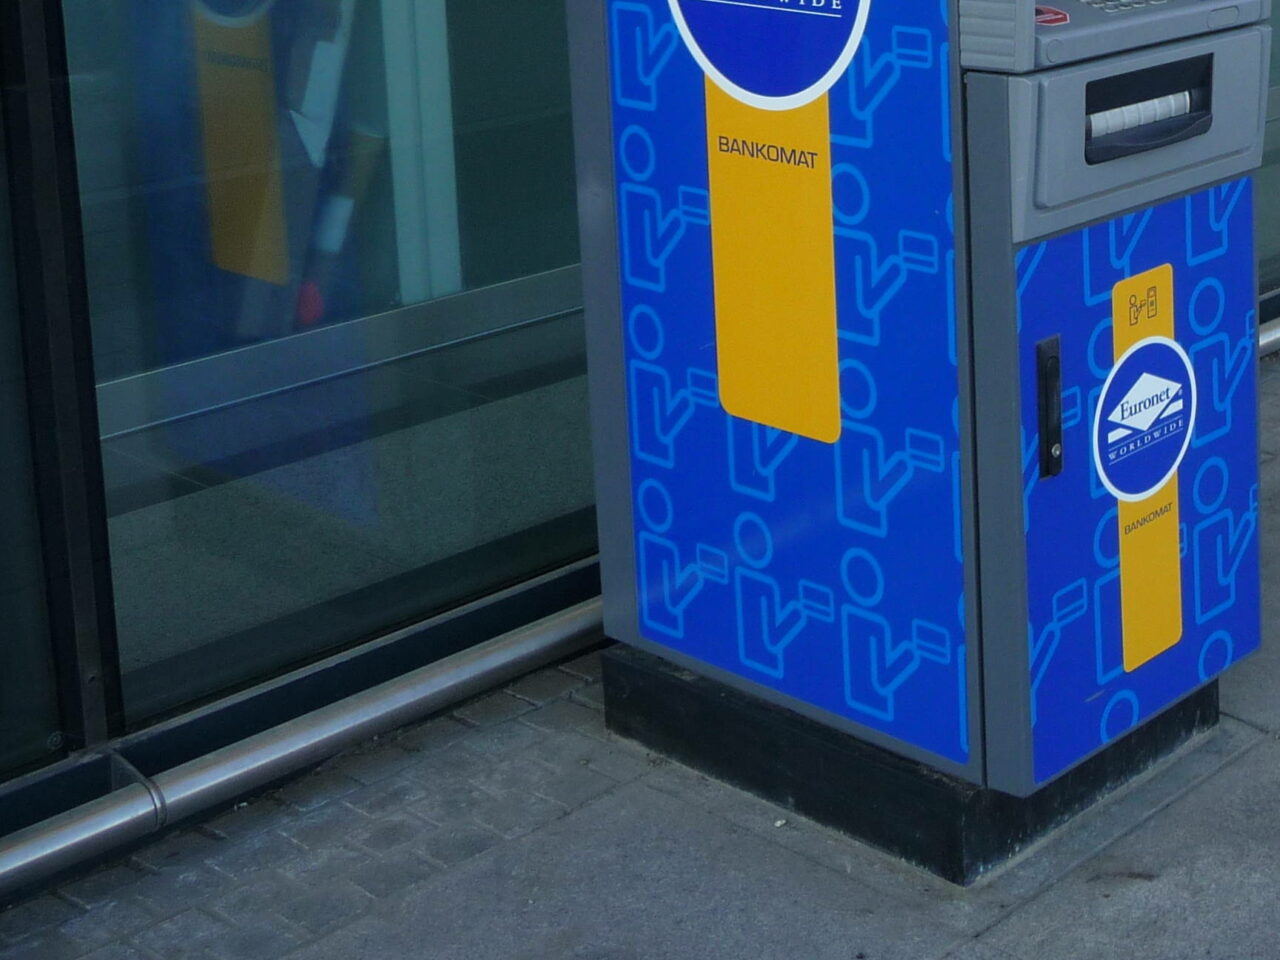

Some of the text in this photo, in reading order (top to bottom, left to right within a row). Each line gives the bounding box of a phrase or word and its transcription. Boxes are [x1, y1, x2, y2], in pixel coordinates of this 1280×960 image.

[719, 136, 818, 169] BANKOMAT
[1120, 387, 1170, 421] Euronet
[1109, 419, 1184, 461] WORLDWIDE
[1124, 502, 1173, 536] BANKOMAT
